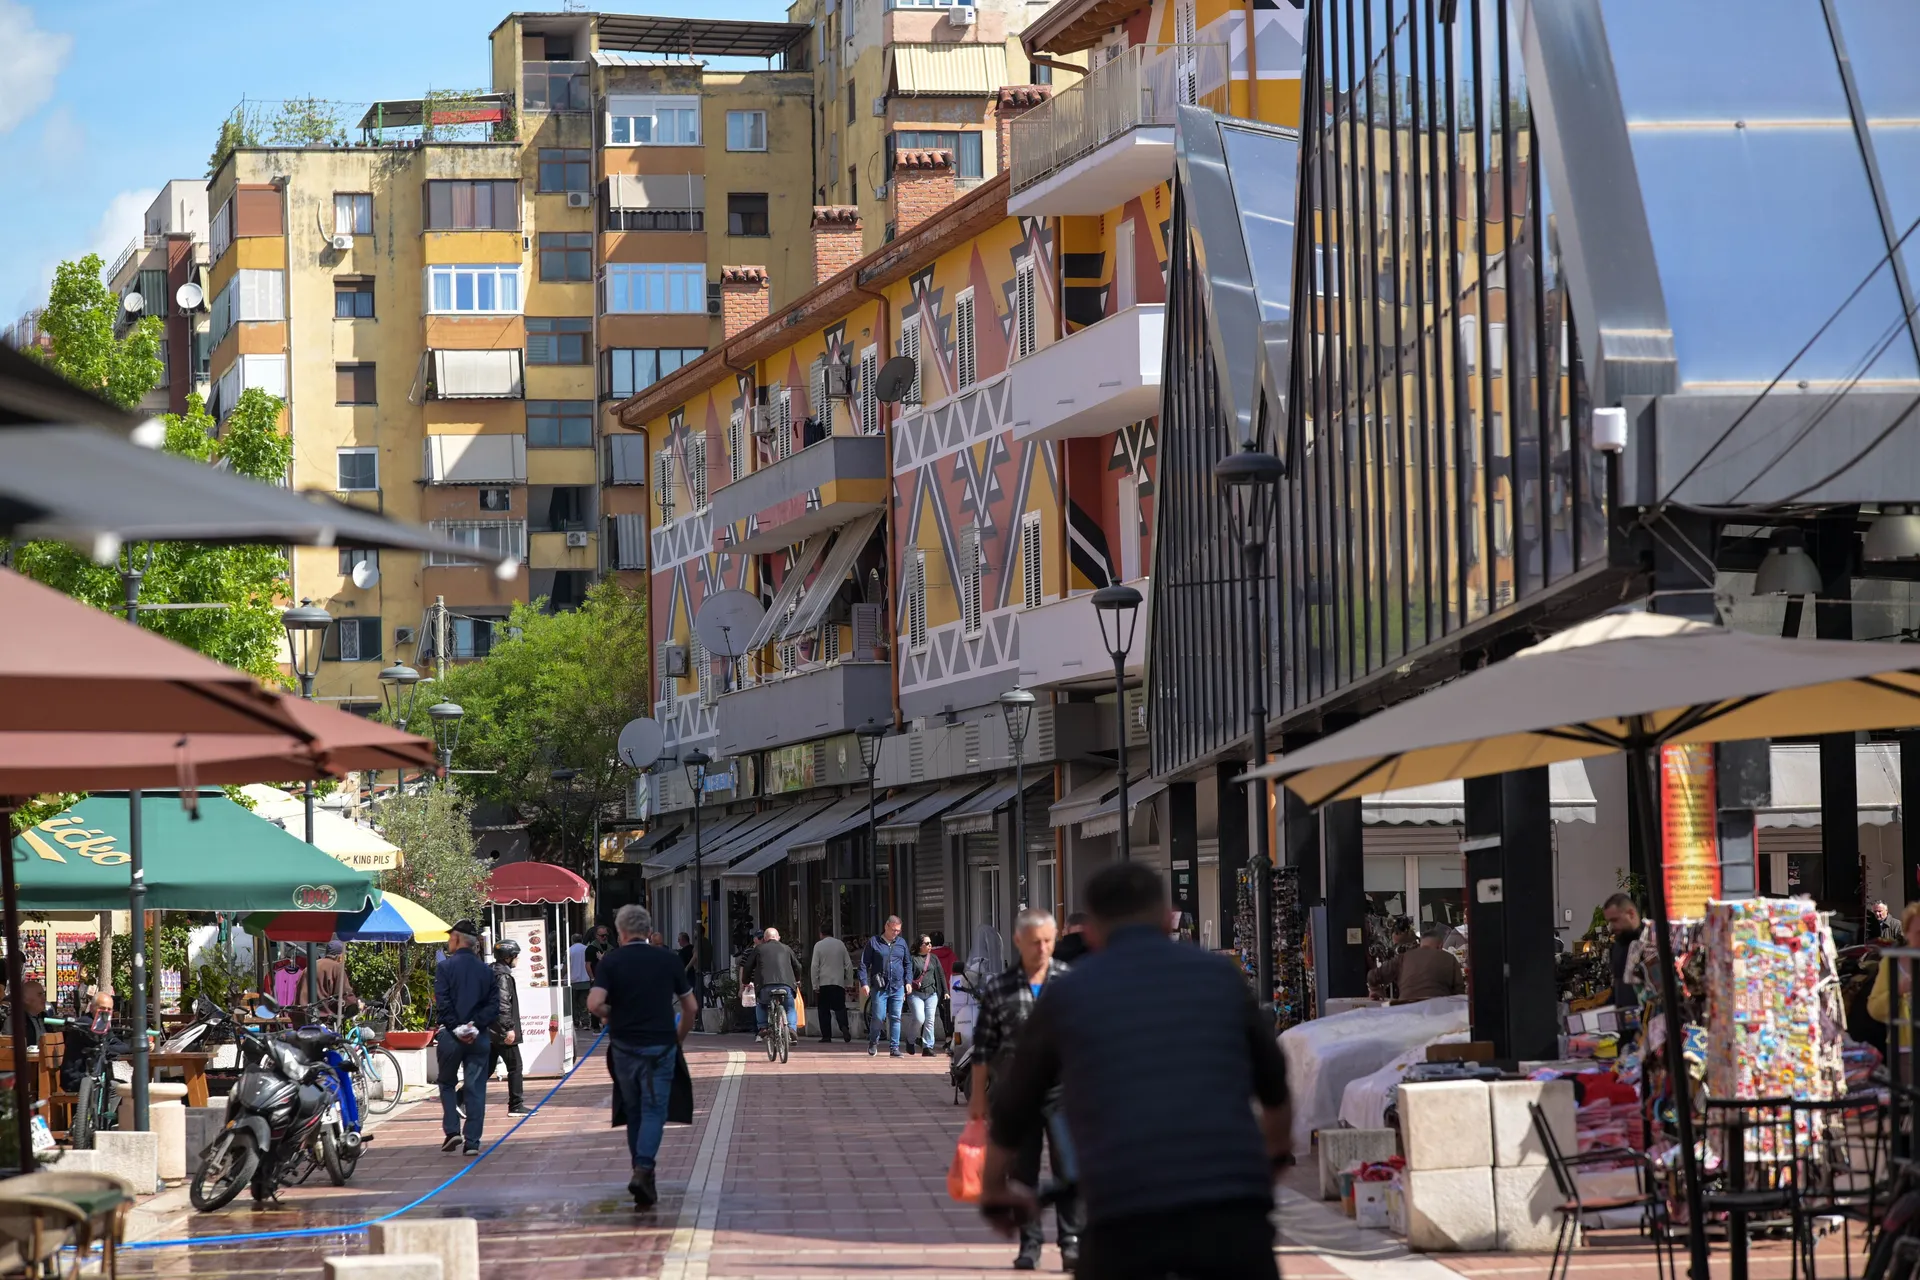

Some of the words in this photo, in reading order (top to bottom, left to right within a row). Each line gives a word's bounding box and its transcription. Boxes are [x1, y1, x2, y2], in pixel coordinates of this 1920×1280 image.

[353, 855, 372, 864] KING
[373, 855, 390, 864] PILS
[302, 888, 330, 905] 1896
